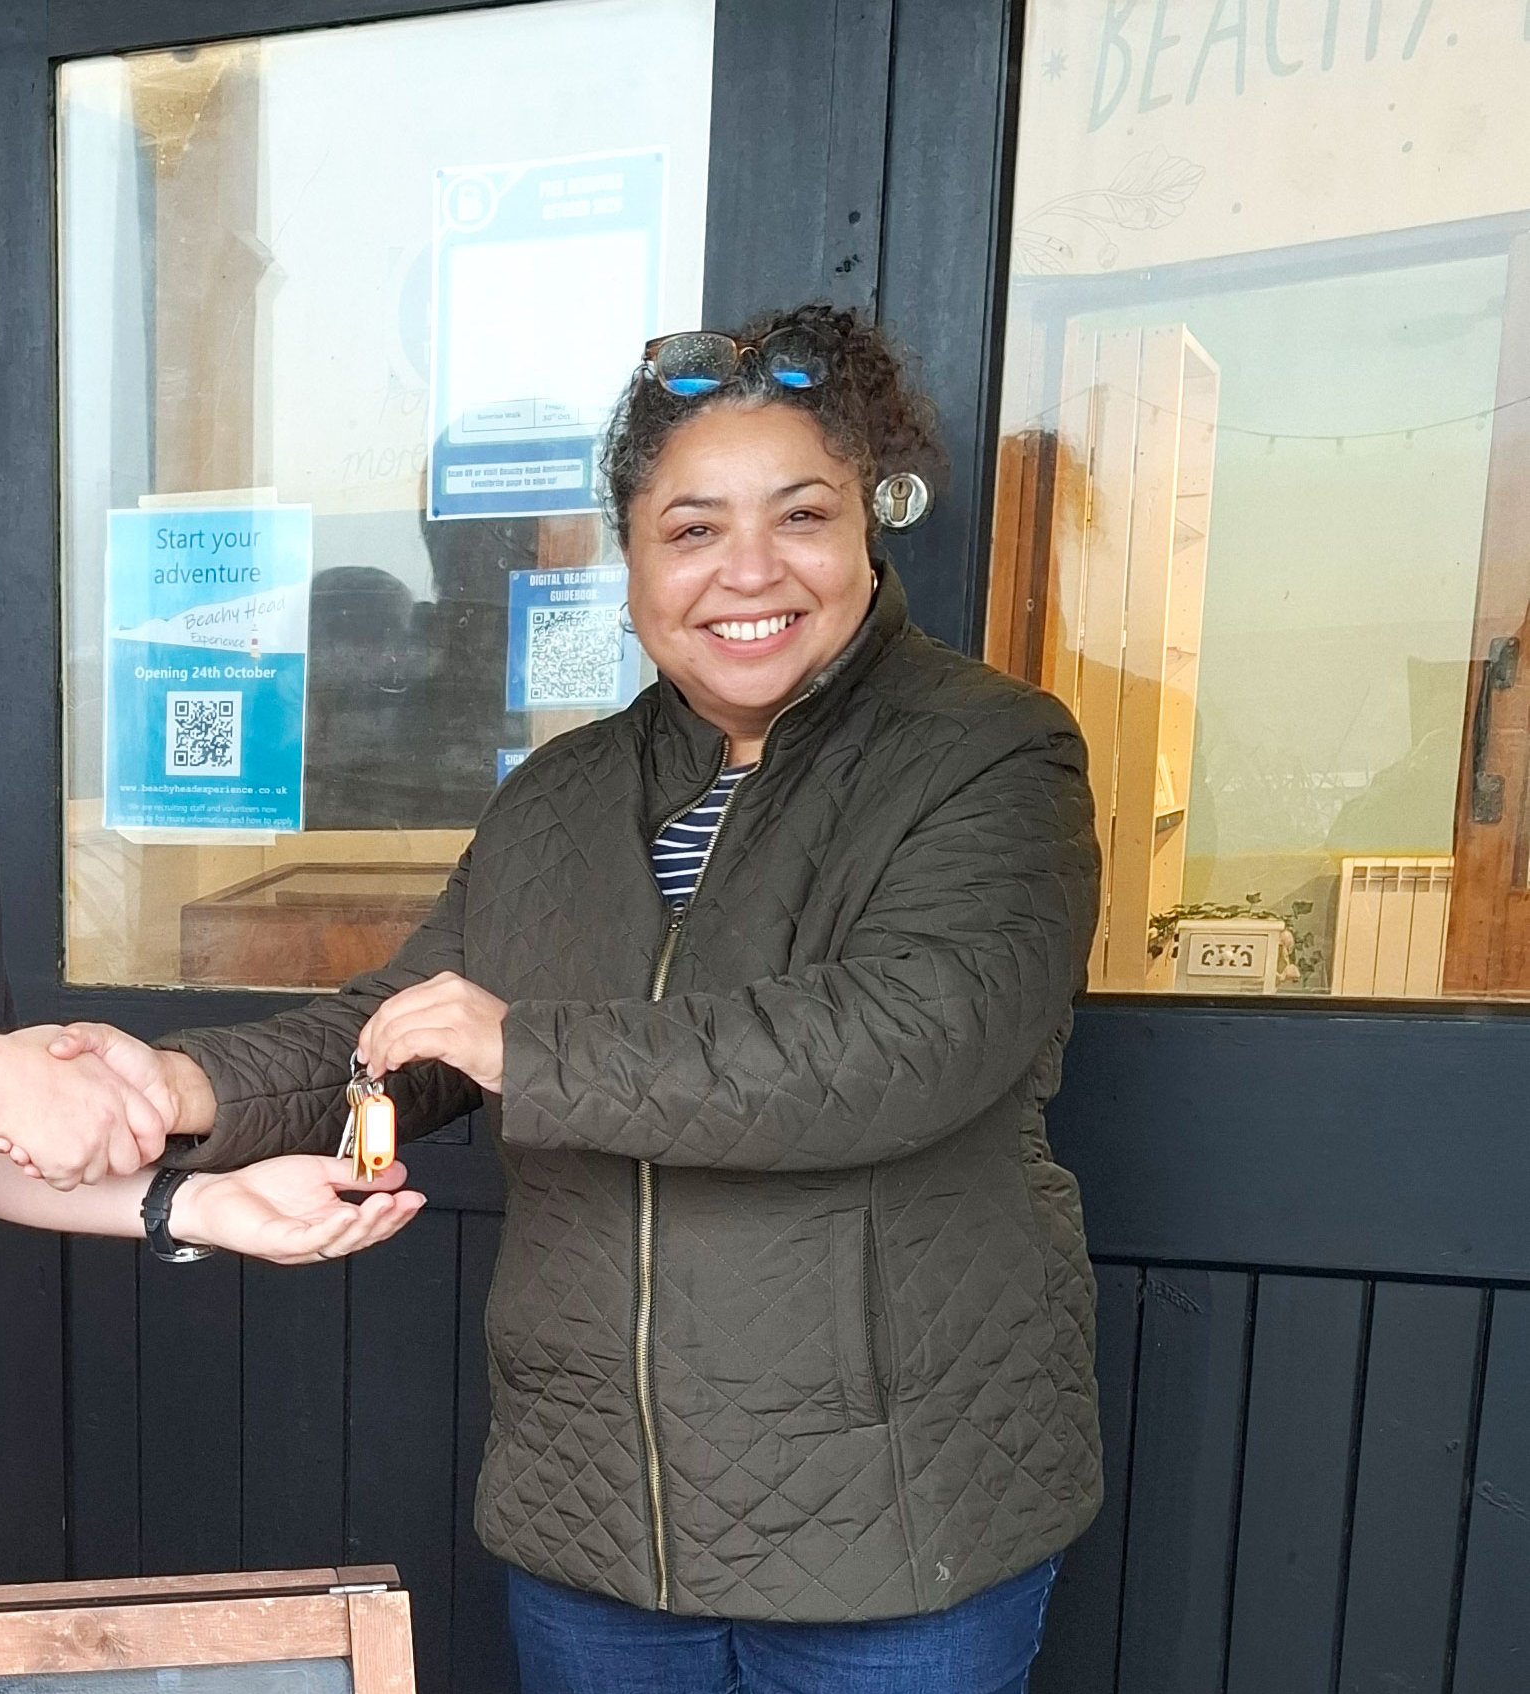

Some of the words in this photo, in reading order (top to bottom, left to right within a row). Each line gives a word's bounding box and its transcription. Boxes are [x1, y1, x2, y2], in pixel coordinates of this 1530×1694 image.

[156, 528, 205, 549] Start
[211, 530, 261, 555] your
[154, 562, 261, 584] adventure
[529, 574, 562, 587] DIGITAL
[563, 572, 598, 585] BEACHY
[550, 589, 599, 602] GUIDEBOOK
[183, 607, 240, 630] Beachy
[244, 598, 285, 619] Head
[190, 632, 246, 649] Experience
[134, 666, 188, 682] Opening
[191, 666, 221, 679] 24th
[224, 666, 277, 679] October
